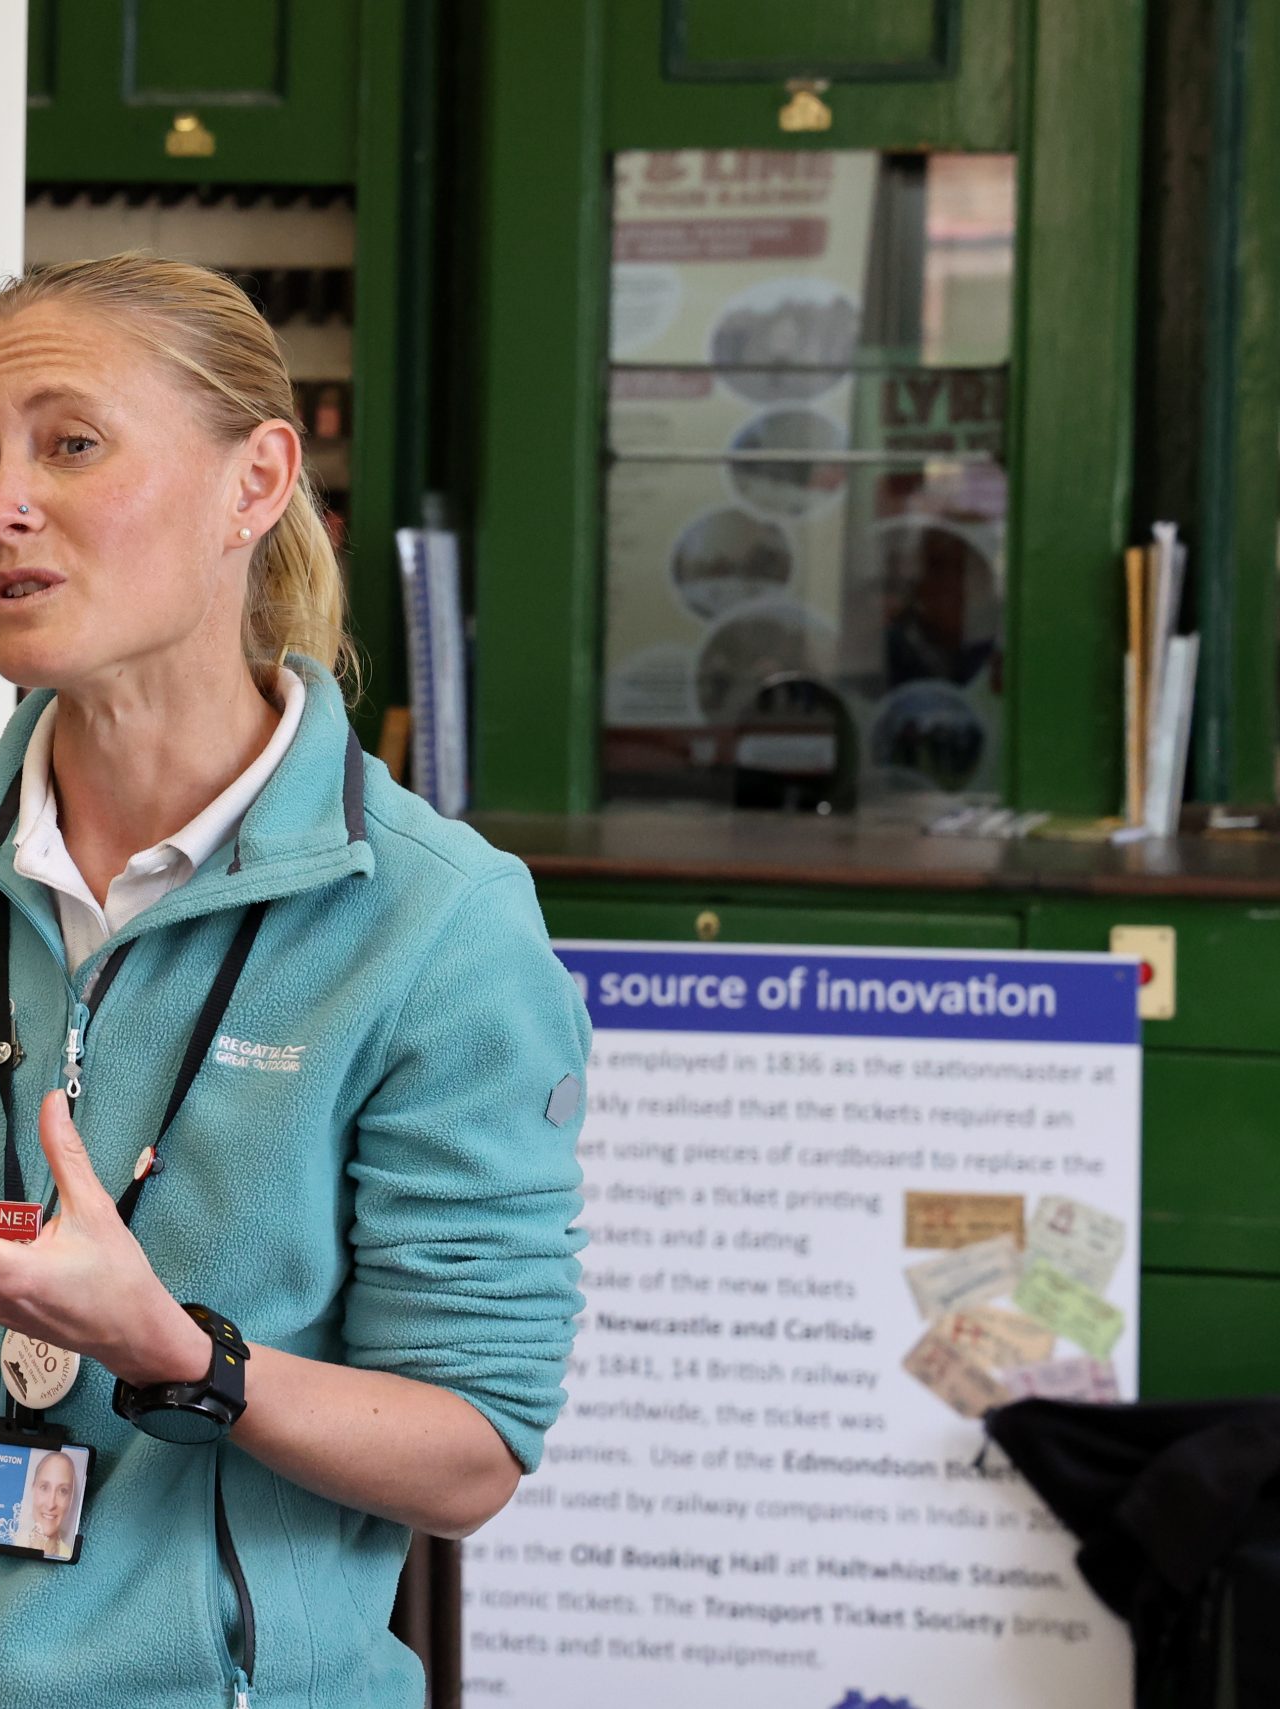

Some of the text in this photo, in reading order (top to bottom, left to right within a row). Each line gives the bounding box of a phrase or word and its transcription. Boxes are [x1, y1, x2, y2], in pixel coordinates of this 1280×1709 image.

[599, 972, 748, 1009] source
[757, 965, 808, 1010] of
[816, 967, 1056, 1018] innovation
[216, 1051, 301, 1072] GREAT OUTDOORS
[218, 1035, 281, 1059] REGATTA
[607, 1050, 729, 1074] employed
[863, 1055, 905, 1077] the
[913, 1057, 1082, 1083] stationmaster
[1091, 1064, 1115, 1085] at
[636, 1092, 733, 1118] realised
[739, 1095, 788, 1119] that
[795, 1097, 835, 1120] the
[842, 1100, 923, 1125] tickets
[928, 1104, 1037, 1131] required
[1043, 1110, 1075, 1130] an
[612, 1142, 676, 1166] using
[683, 1142, 760, 1167] pieces
[798, 1143, 924, 1170] cardboard
[963, 1154, 1055, 1176] replace
[1062, 1153, 1106, 1177] the
[605, 1180, 686, 1209] design
[712, 1182, 779, 1206] ticket
[785, 1187, 881, 1216] printing
[659, 1226, 811, 1258] and dating
[670, 1268, 711, 1293] the
[717, 1276, 768, 1294] new
[776, 1274, 856, 1299] tickets
[595, 1310, 722, 1337] Newcastle
[730, 1317, 778, 1340] and
[784, 1317, 876, 1343] Carlisle
[28, 1338, 57, 1373] 00
[707, 1357, 786, 1382] British
[791, 1363, 880, 1391] railway
[575, 1400, 711, 1426] worldwide,
[716, 1402, 757, 1425] the
[763, 1405, 831, 1429] ticket
[837, 1413, 887, 1432] was
[649, 1443, 696, 1468] Use
[702, 1443, 728, 1470] of
[735, 1445, 776, 1471] the
[782, 1450, 940, 1480] Edmondson
[562, 1486, 619, 1510] used
[625, 1489, 655, 1515] by
[661, 1494, 748, 1520] railway
[754, 1500, 889, 1523] companies
[925, 1506, 988, 1528] India
[523, 1541, 563, 1563] the
[570, 1542, 615, 1567] Old
[621, 1547, 721, 1575] Booking
[729, 1548, 779, 1574] Hall
[816, 1557, 962, 1584] Haltwhistle
[479, 1589, 549, 1611] iconic
[650, 1594, 693, 1617] The
[703, 1596, 824, 1625] Transport
[831, 1603, 906, 1629] Ticket
[912, 1608, 1004, 1637] Society
[1012, 1614, 1090, 1644] brings
[470, 1630, 823, 1670] tickets and ticket equipment.
